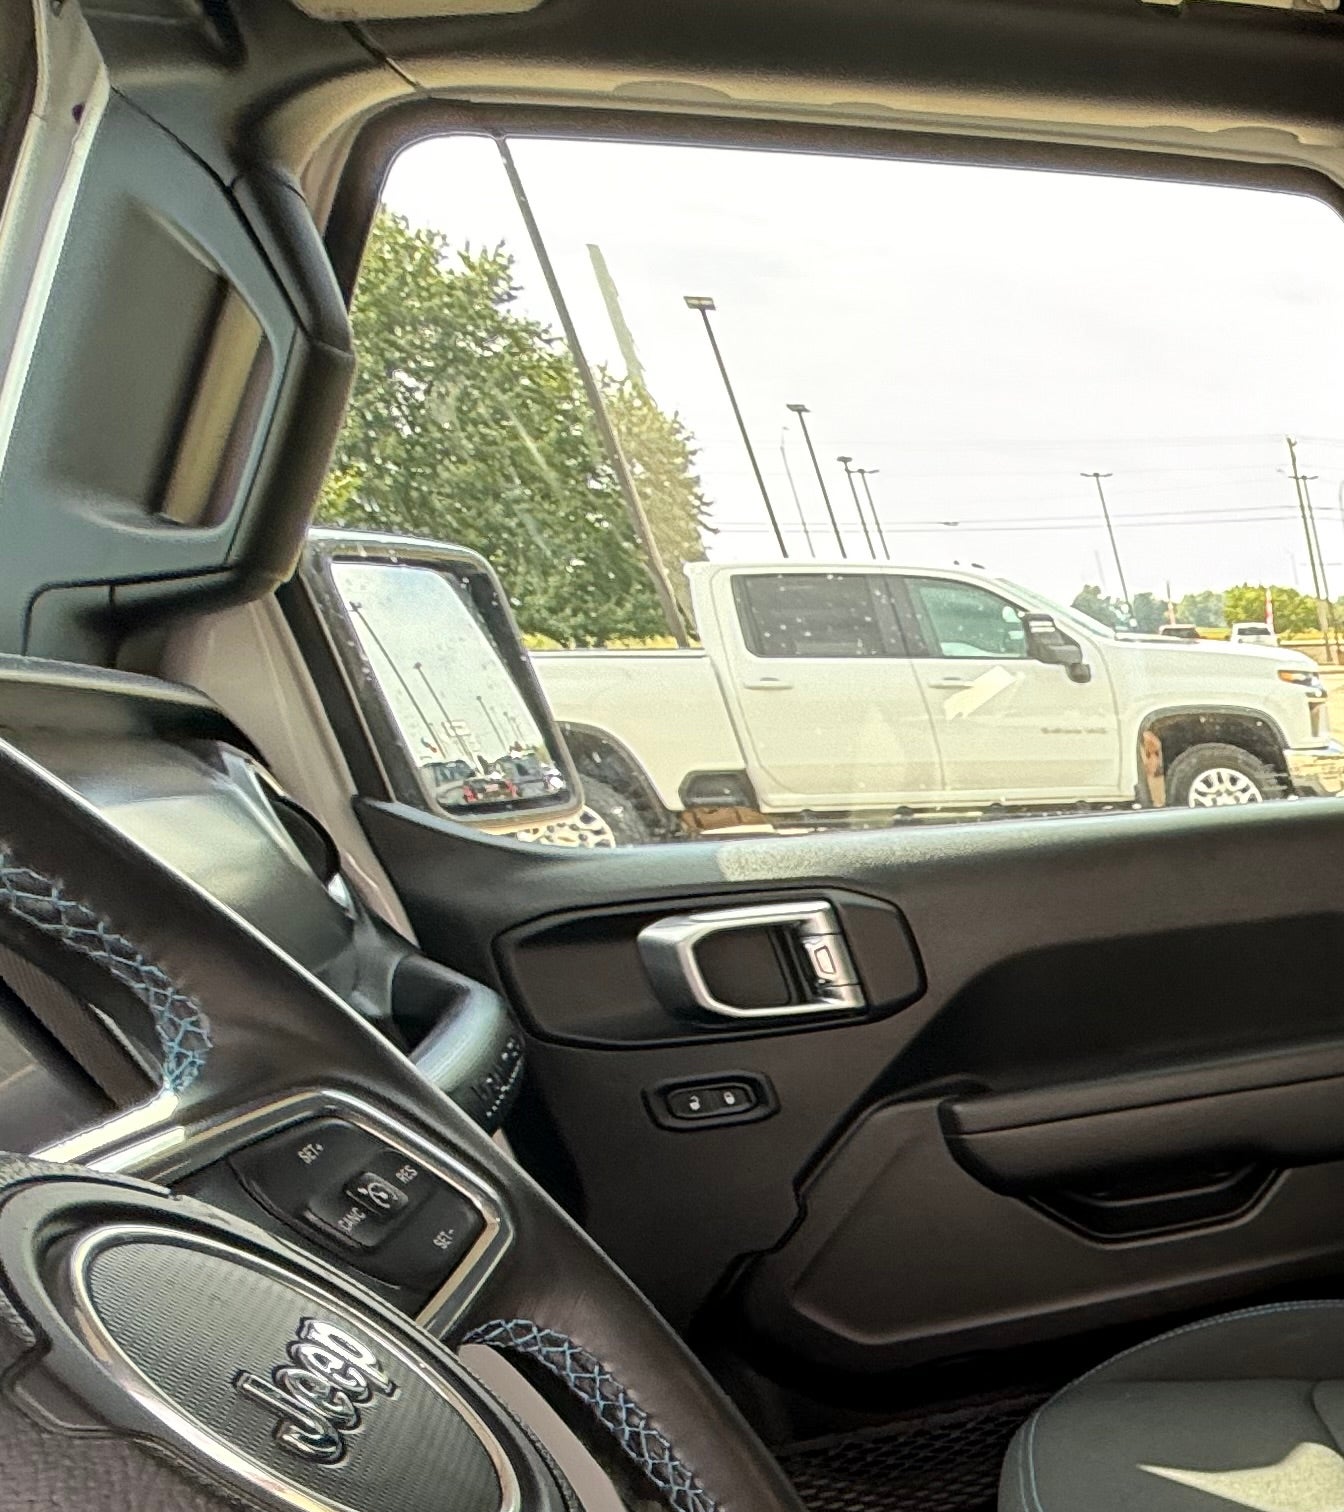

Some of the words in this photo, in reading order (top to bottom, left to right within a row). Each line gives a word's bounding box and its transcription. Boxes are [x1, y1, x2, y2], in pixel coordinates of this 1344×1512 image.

[396, 1164, 418, 1184] RES
[337, 1207, 366, 1234] CANC
[232, 1317, 397, 1465] Jeep
